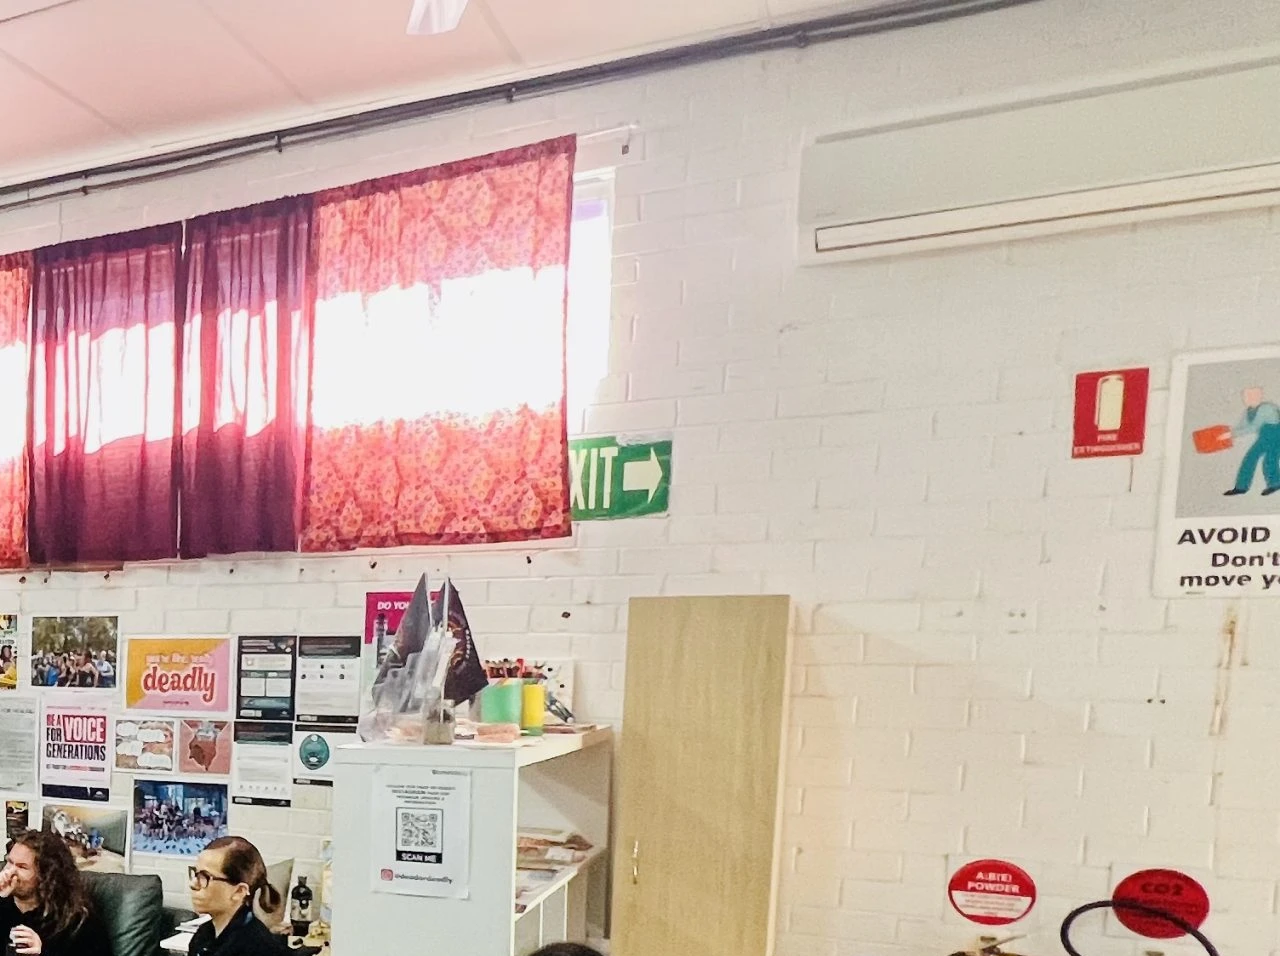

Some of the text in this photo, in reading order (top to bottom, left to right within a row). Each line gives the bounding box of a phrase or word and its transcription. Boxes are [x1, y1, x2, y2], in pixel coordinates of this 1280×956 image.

[568, 446, 618, 510] XIT
[1177, 526, 1271, 545] AVOID
[1211, 552, 1280, 568] Don't
[1180, 574, 1280, 590] move y
[377, 601, 392, 610] DO
[143, 666, 215, 702] deadly
[47, 714, 55, 726] BE
[64, 716, 104, 742] VOICE
[47, 728, 61, 742] FOR
[46, 743, 106, 761] GENERATIONS
[401, 853, 437, 863] SCAN ME
[967, 881, 1020, 893] POWDER
[1141, 882, 1184, 896] CO2
